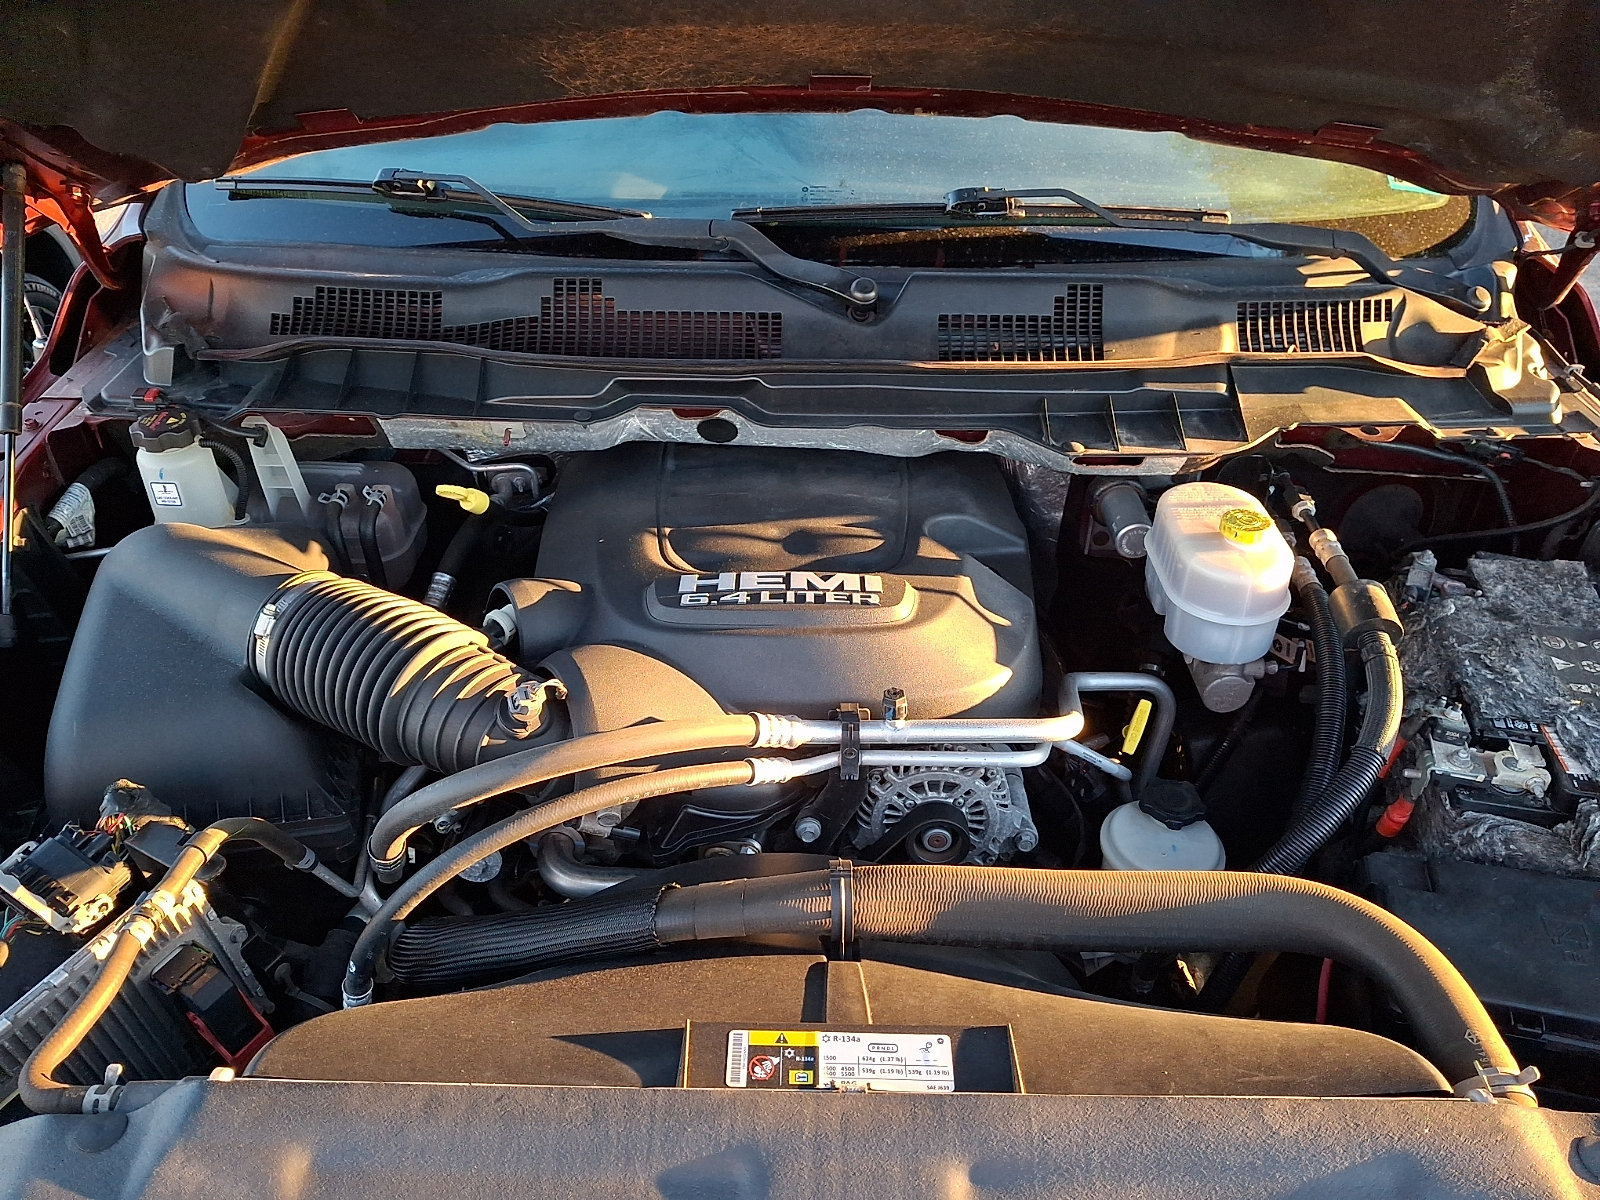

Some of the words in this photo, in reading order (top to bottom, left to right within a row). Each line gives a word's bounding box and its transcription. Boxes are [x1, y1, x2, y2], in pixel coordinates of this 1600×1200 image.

[678, 571, 883, 593] HEMI
[680, 591, 750, 606] 6.4
[760, 591, 881, 606] LITER
[833, 1035, 861, 1043] R-134a
